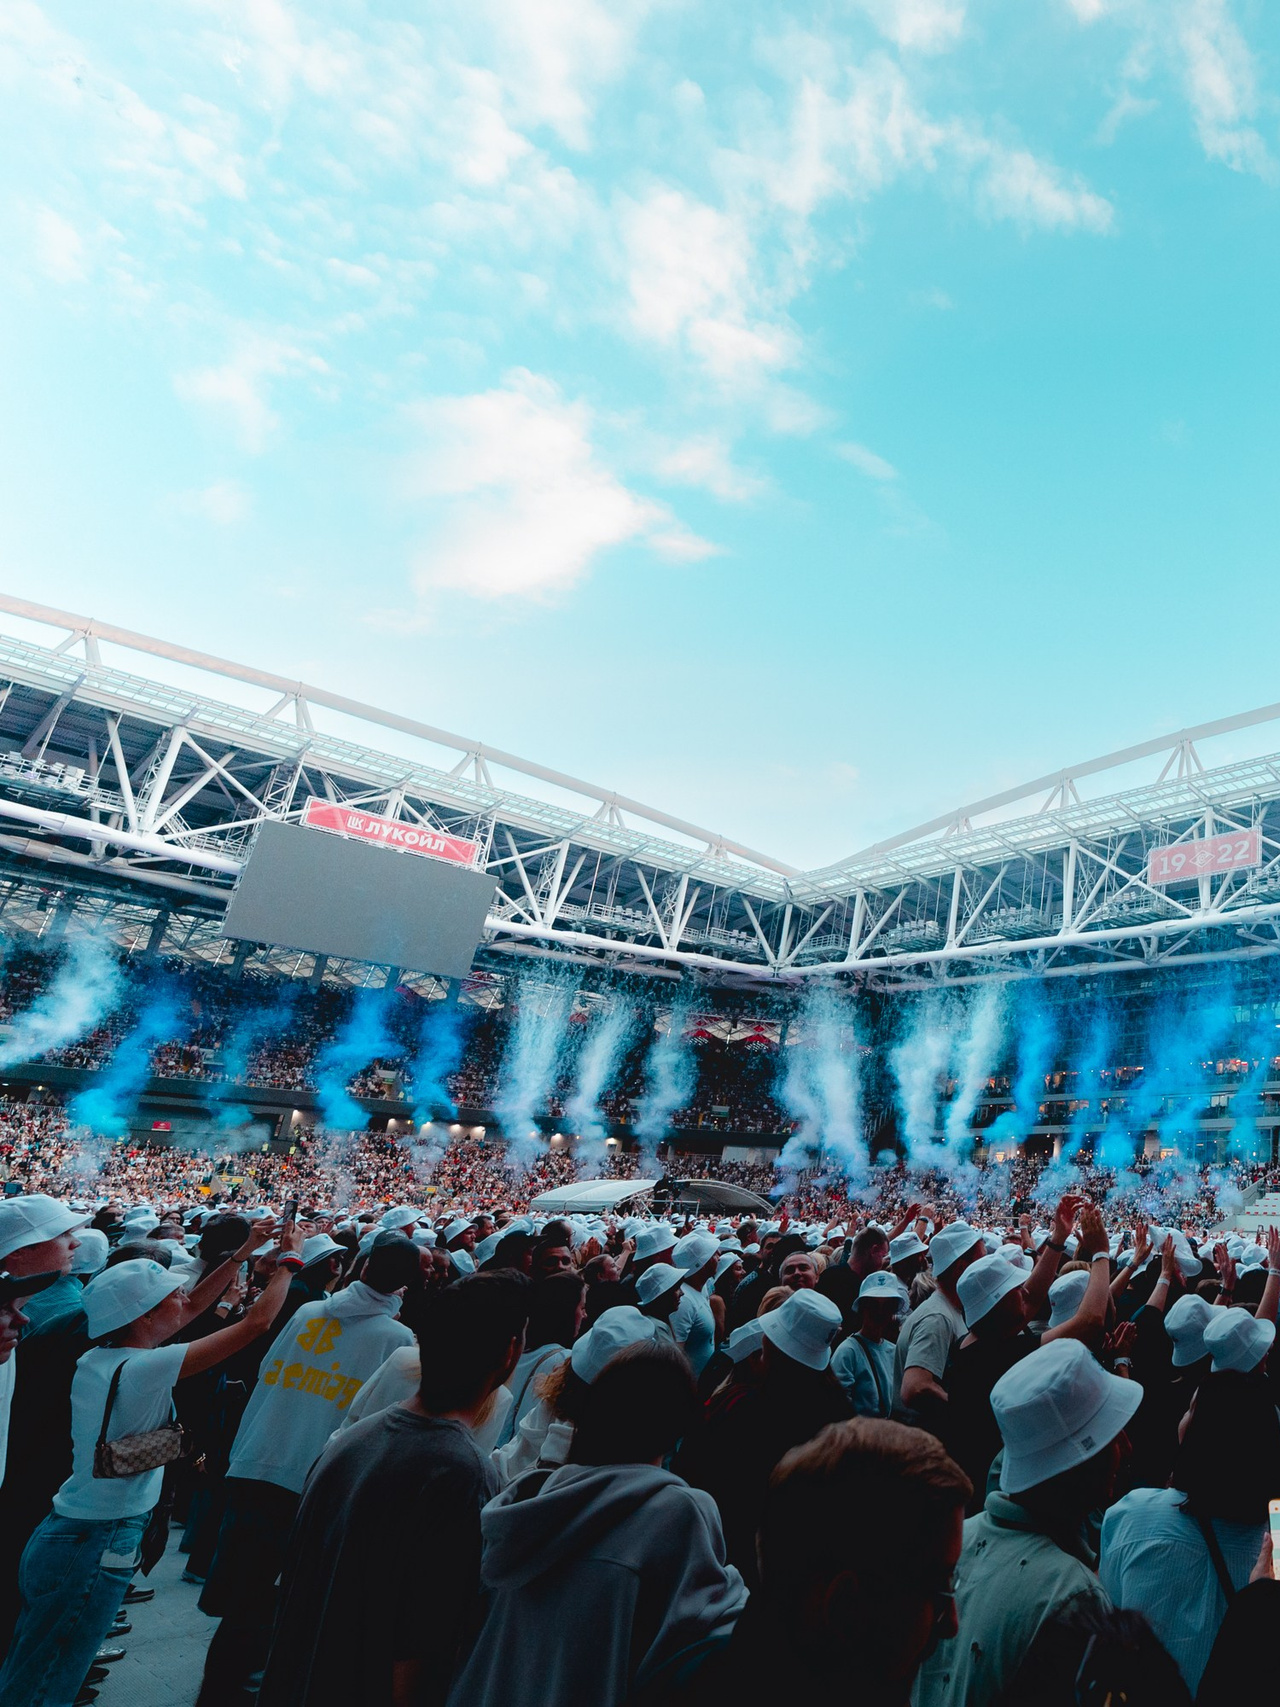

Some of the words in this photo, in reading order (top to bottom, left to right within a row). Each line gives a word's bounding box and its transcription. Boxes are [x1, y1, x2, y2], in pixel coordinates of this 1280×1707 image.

[365, 821, 446, 852] ЛУКОЙЛ
[1159, 853, 1187, 875] 19
[1216, 840, 1249, 864] 22
